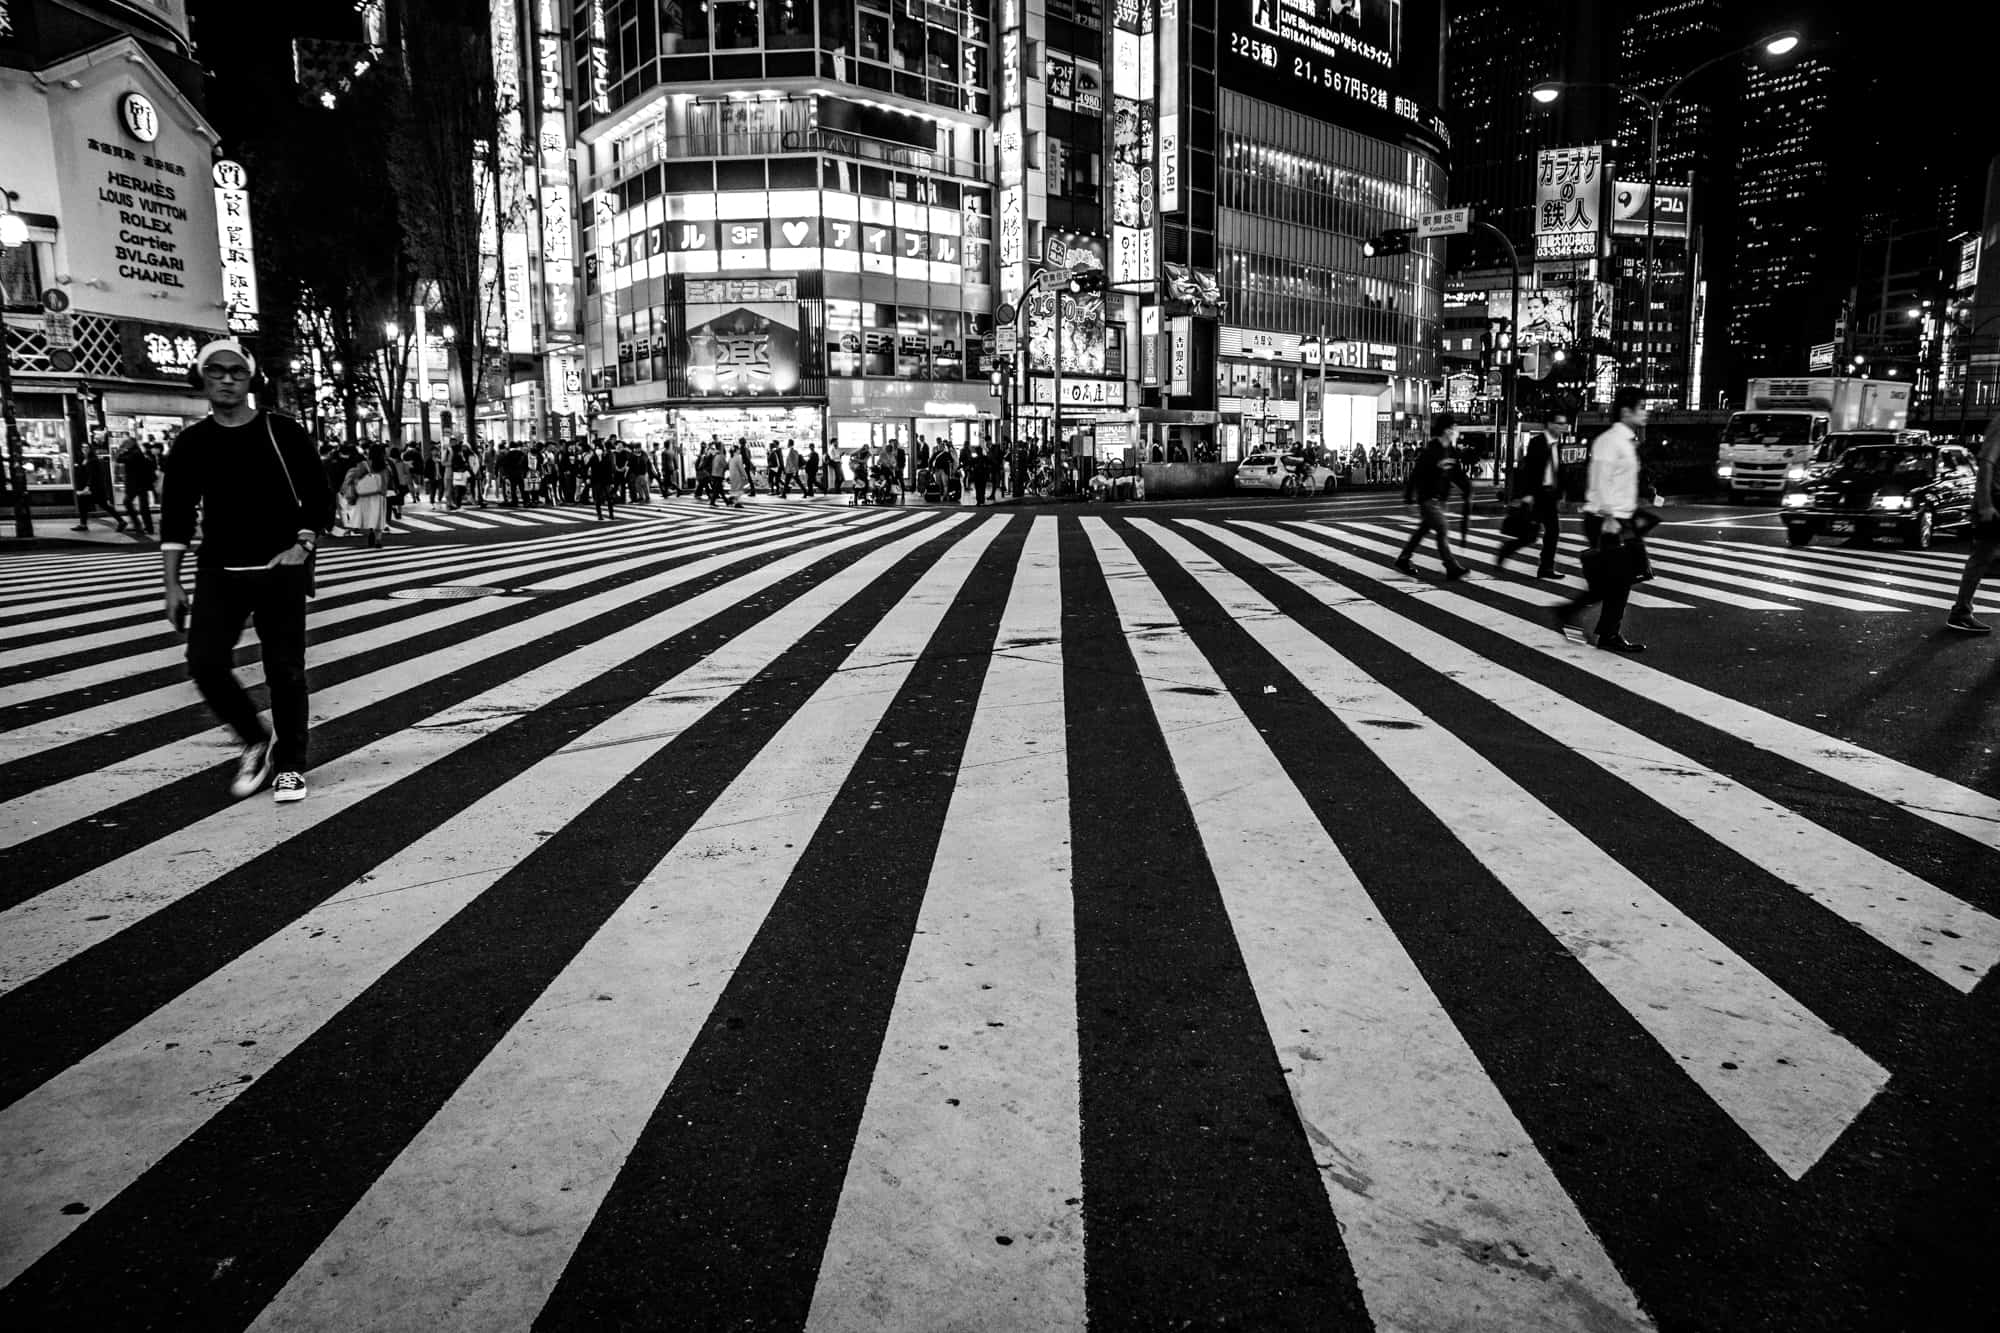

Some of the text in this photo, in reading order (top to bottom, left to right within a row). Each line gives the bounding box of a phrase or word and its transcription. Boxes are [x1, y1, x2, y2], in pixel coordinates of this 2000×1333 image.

[1281, 9, 1298, 27] LIVE
[1047, 59, 1074, 81] まつげ
[1394, 95, 1419, 123] 前日比
[1166, 154, 1175, 192] LABI
[1540, 151, 1601, 185] カラオケ
[107, 170, 176, 200] HERMÈS
[1561, 182, 1575, 202] の
[98, 186, 187, 221] LOUIS VUITTON
[1542, 199, 1592, 231] 鉄人
[119, 210, 173, 235] ROLEX
[731, 225, 759, 245] 3F
[119, 229, 176, 253] Cartier
[832, 222, 955, 262] アイフル
[115, 246, 184, 272] BVLGARI
[118, 264, 184, 288] CHANEL
[1109, 384, 1121, 397] 24
